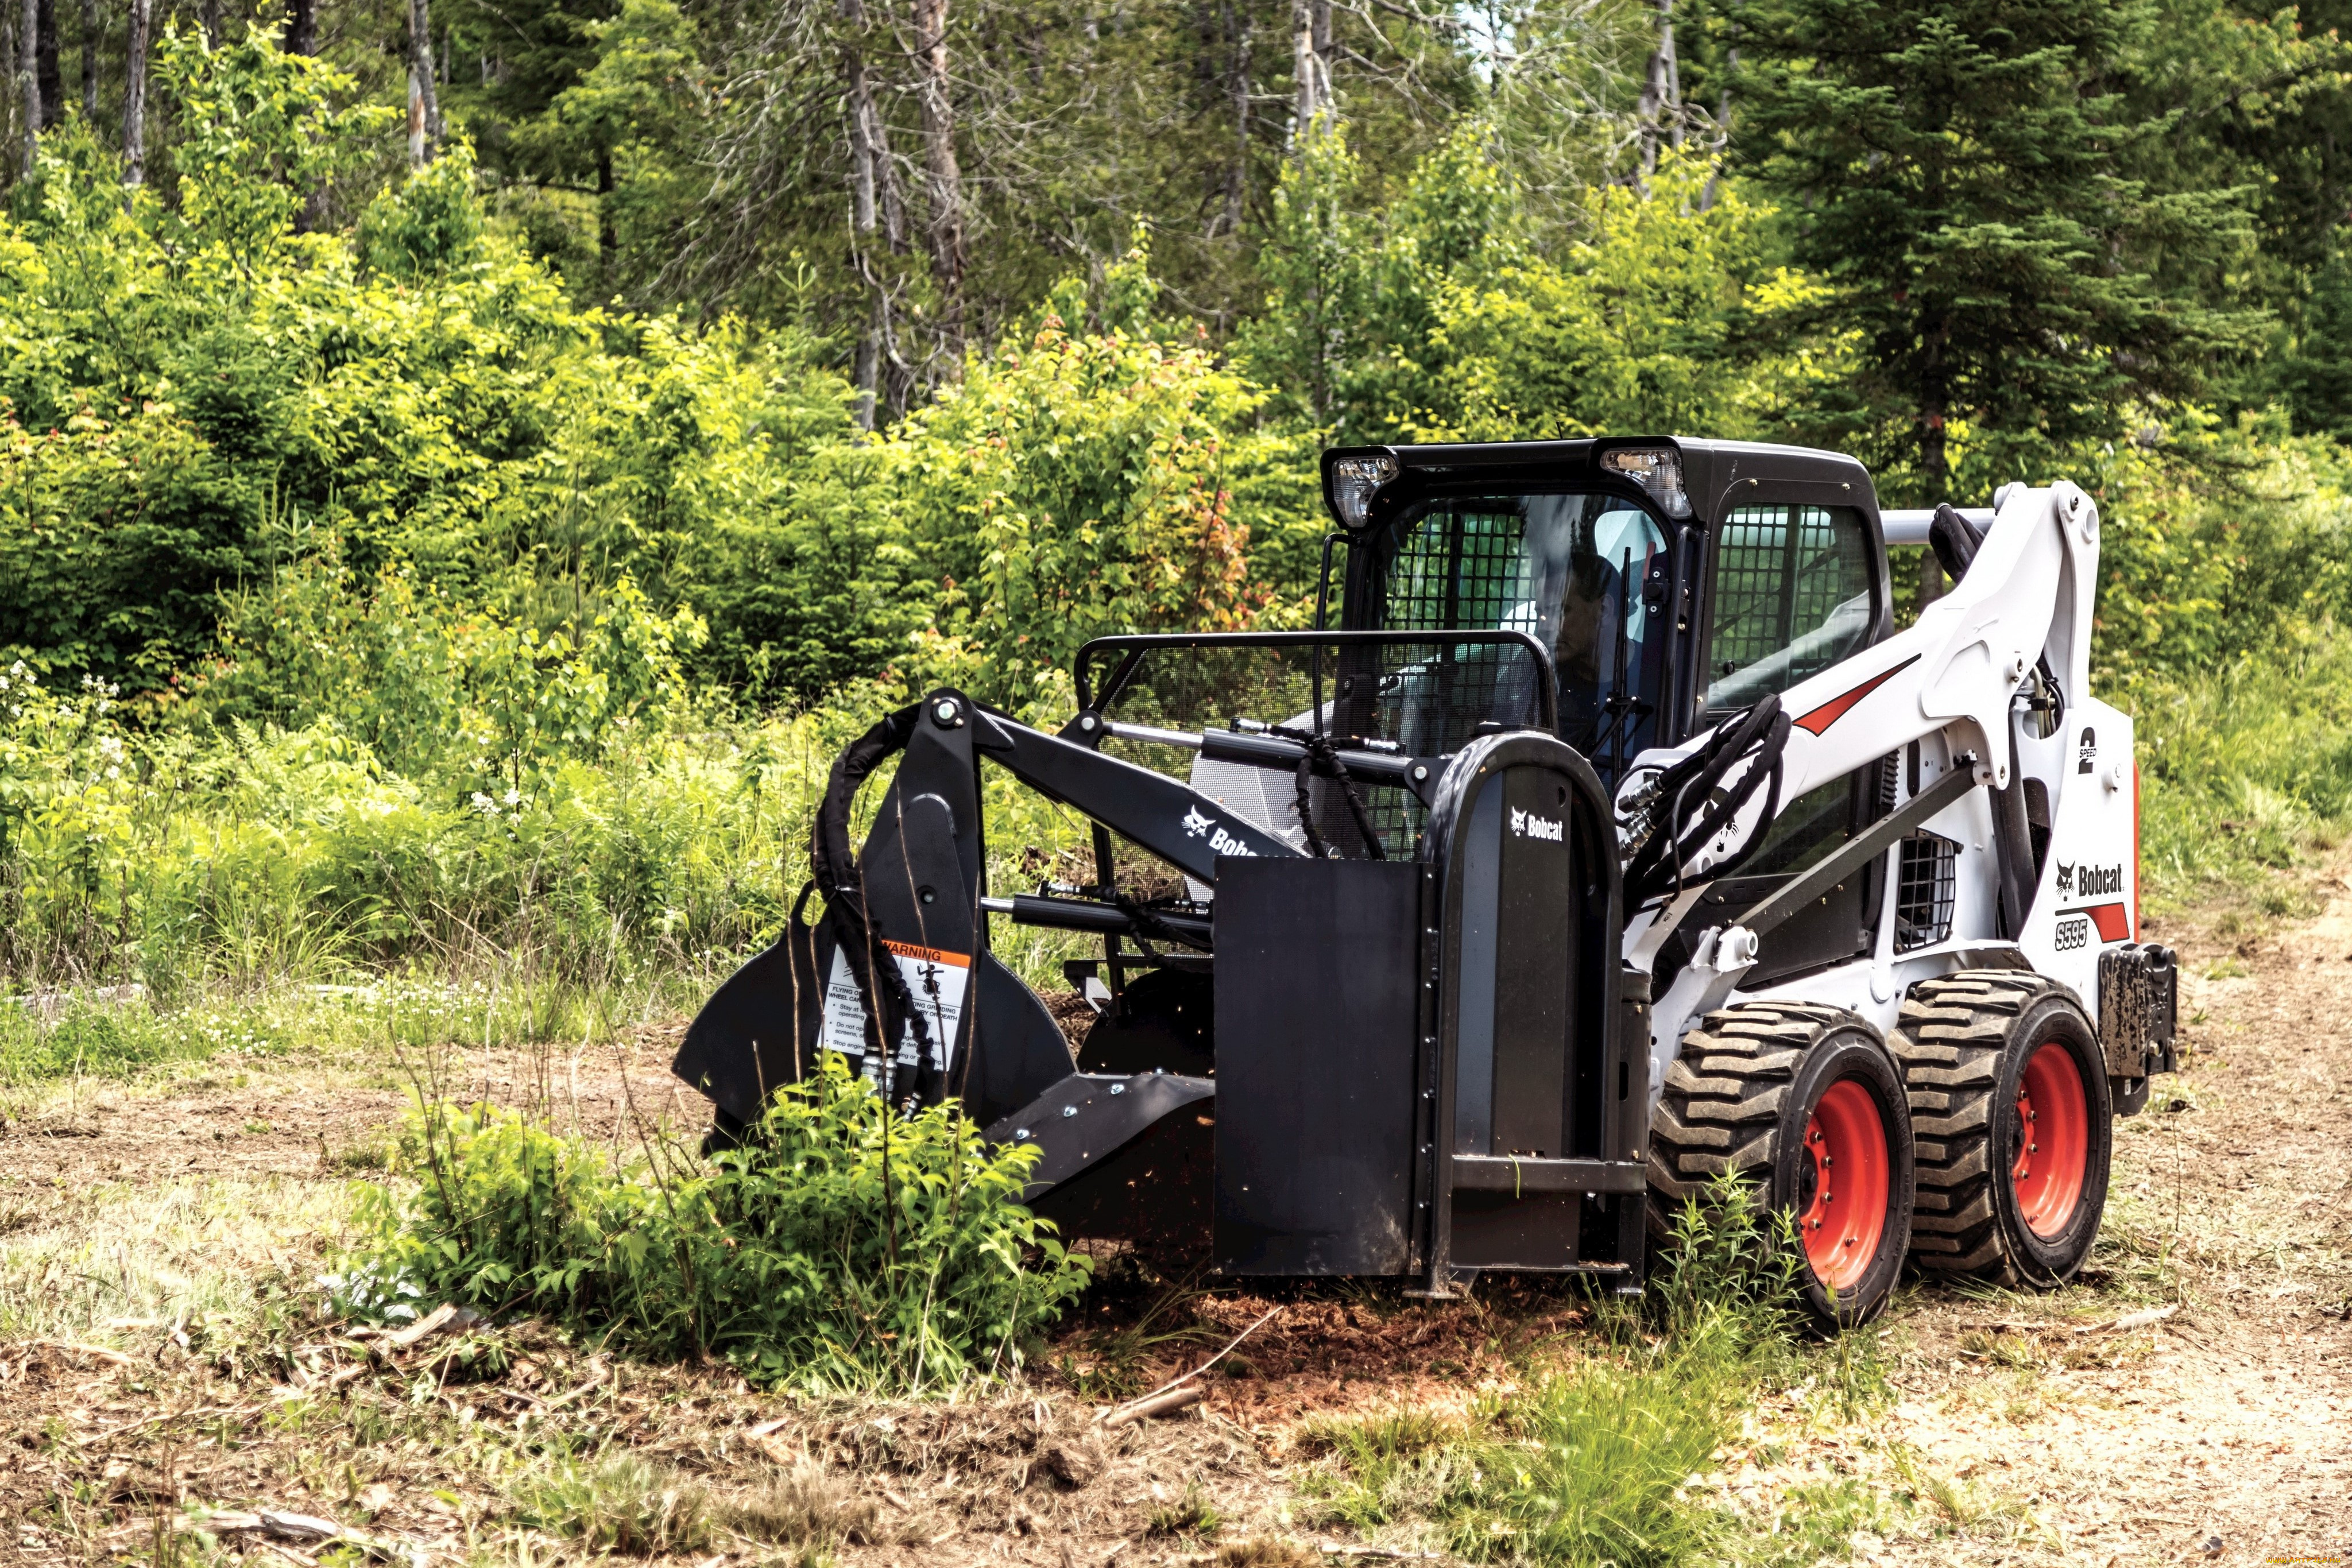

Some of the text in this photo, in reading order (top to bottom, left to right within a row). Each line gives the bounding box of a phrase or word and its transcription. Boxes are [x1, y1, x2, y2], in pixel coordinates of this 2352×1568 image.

[2079, 748, 2097, 758] SPEED
[1209, 827, 1258, 855] Bob
[1528, 815, 1562, 841] Bobcat
[2079, 864, 2122, 897] Bobcat
[2055, 919, 2088, 951] S595
[829, 992, 848, 1001] WHEEL
[940, 1013, 958, 1021] DEATH
[832, 986, 853, 994] FLYING
[927, 1004, 956, 1014] GRDING
[840, 1004, 852, 1012] Stay
[838, 1011, 864, 1020] operating
[835, 1029, 857, 1037] screens,
